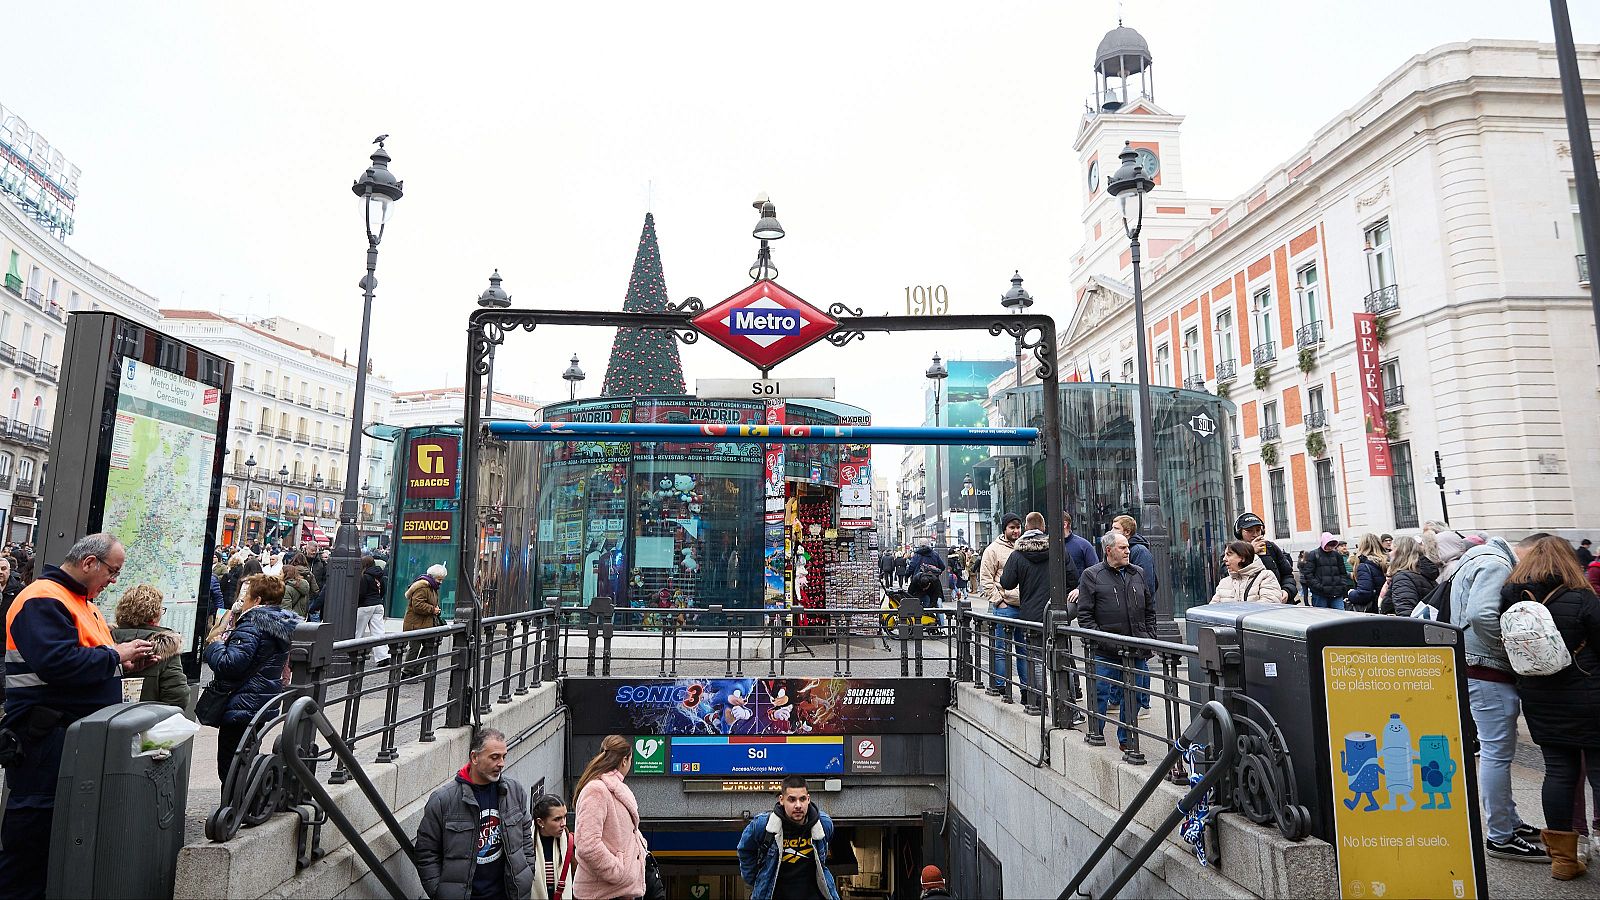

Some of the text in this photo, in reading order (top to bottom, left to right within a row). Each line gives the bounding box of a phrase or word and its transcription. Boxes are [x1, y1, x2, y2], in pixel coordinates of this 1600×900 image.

[904, 284, 950, 316] 1919
[735, 311, 796, 330] Metro
[1359, 319, 1380, 408] BELÉN
[149, 365, 168, 379] Plano
[150, 376, 170, 391] Metro
[171, 384, 190, 398] Ligero
[751, 381, 780, 395] Sol
[156, 390, 187, 407] Cercanías
[573, 410, 613, 423] MADRID
[689, 407, 741, 422] MADRID
[840, 415, 870, 424] MADRID
[1198, 419, 1210, 431] SOL
[410, 478, 450, 487] TABACOS
[404, 520, 449, 531] ESTANCO
[1330, 652, 1445, 669] Deposita dentro latas,
[1331, 665, 1441, 680] briks y otros envases
[846, 688, 895, 697] SOLO EN CINES
[1331, 679, 1435, 692] de plástico o metal.
[615, 683, 703, 708] SONIC 3
[843, 696, 895, 705] 25 DICIEMBRE
[748, 747, 768, 759] Sol
[1343, 835, 1450, 847] No los tires al suelo.
